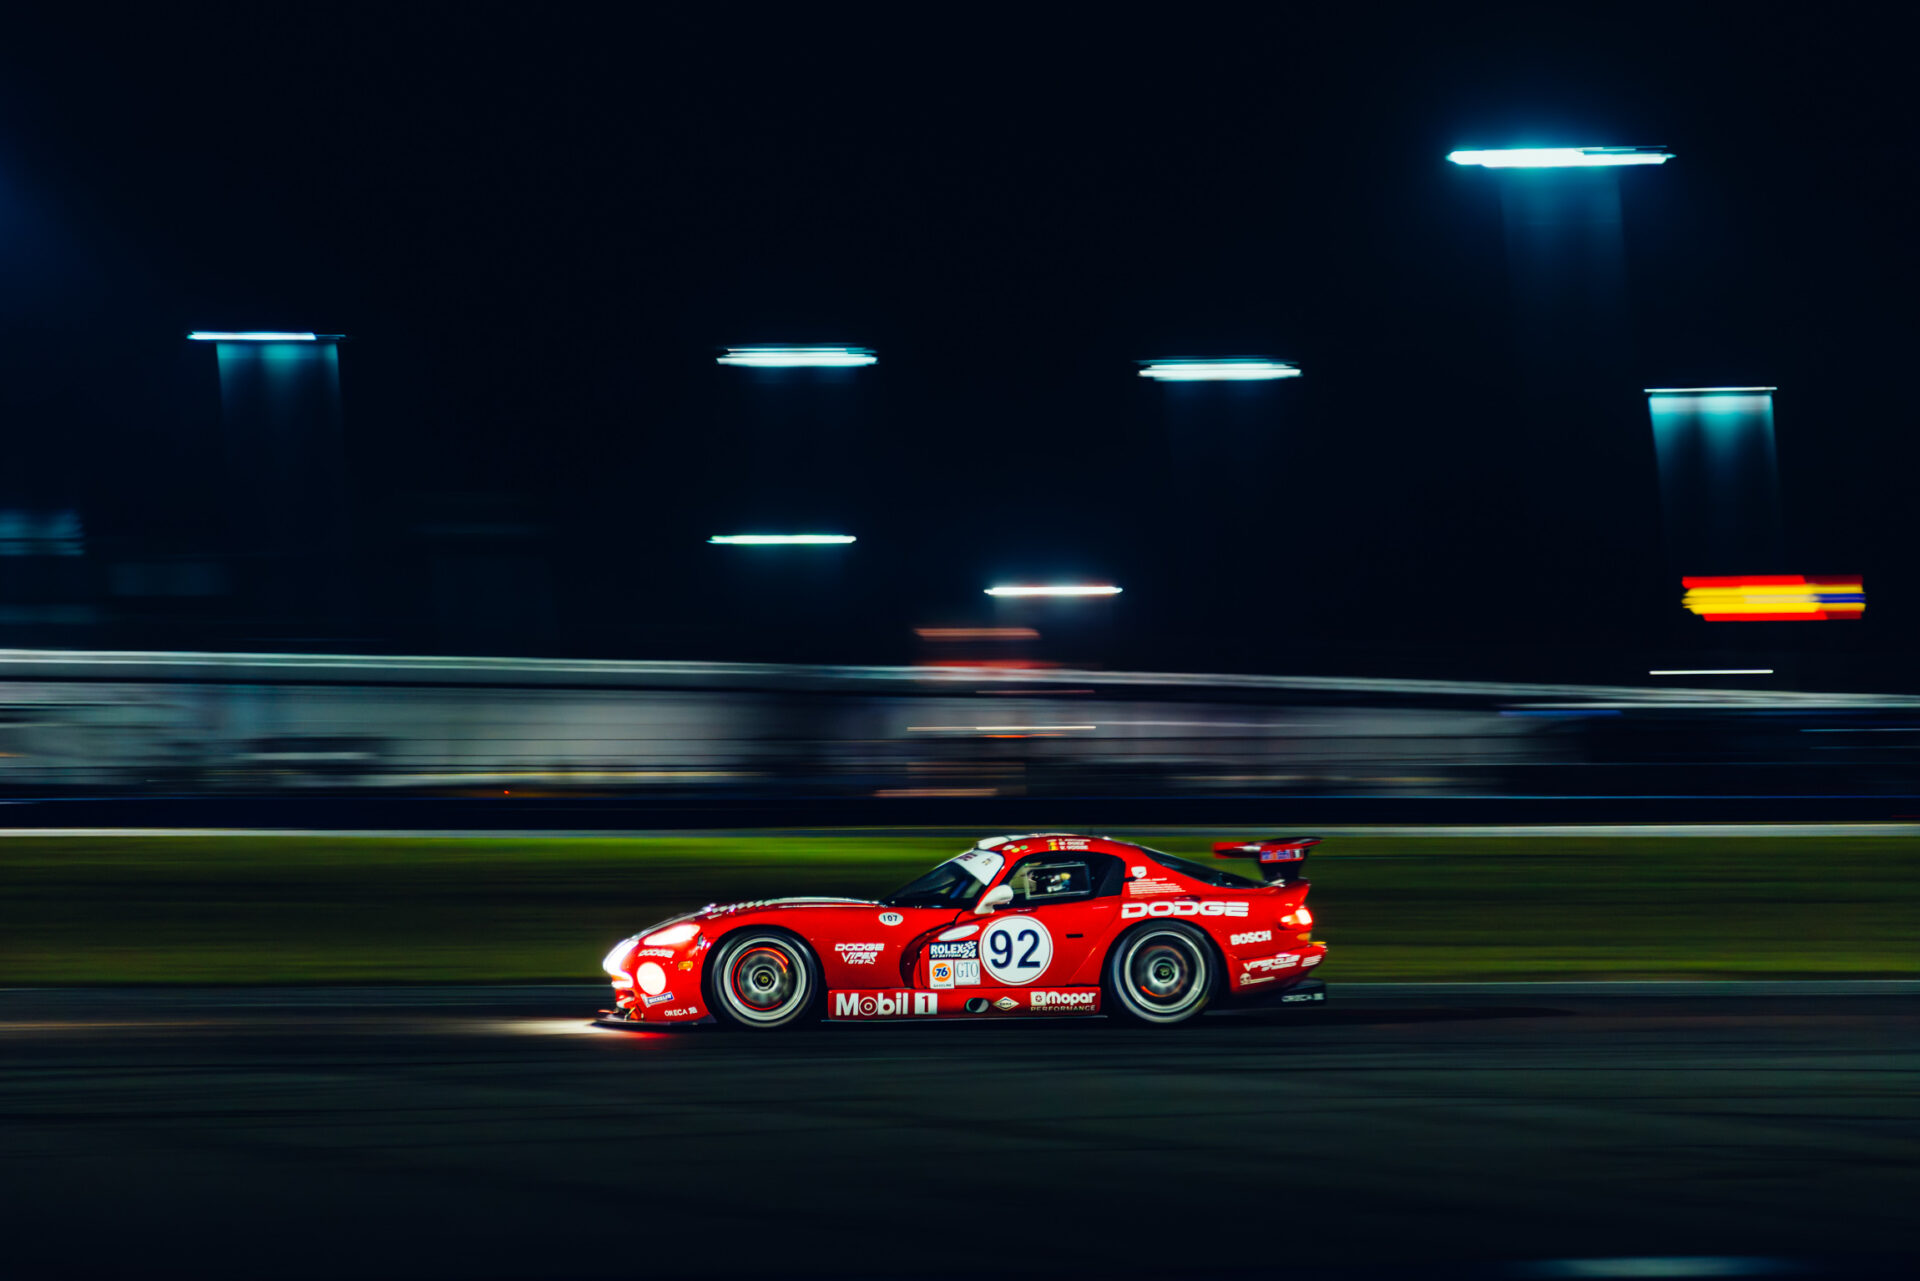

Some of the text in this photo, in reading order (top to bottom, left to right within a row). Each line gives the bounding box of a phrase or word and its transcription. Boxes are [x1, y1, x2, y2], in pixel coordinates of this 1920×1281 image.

[883, 914, 898, 922] 107
[1121, 901, 1249, 919] DODGE
[1230, 930, 1272, 946] BOSCH
[841, 952, 878, 962] VIPER
[930, 943, 977, 959] ROLEX 24
[989, 929, 1041, 969] 92
[935, 967, 948, 977] 76
[956, 961, 978, 978] GTO
[836, 992, 908, 1016] Mobil
